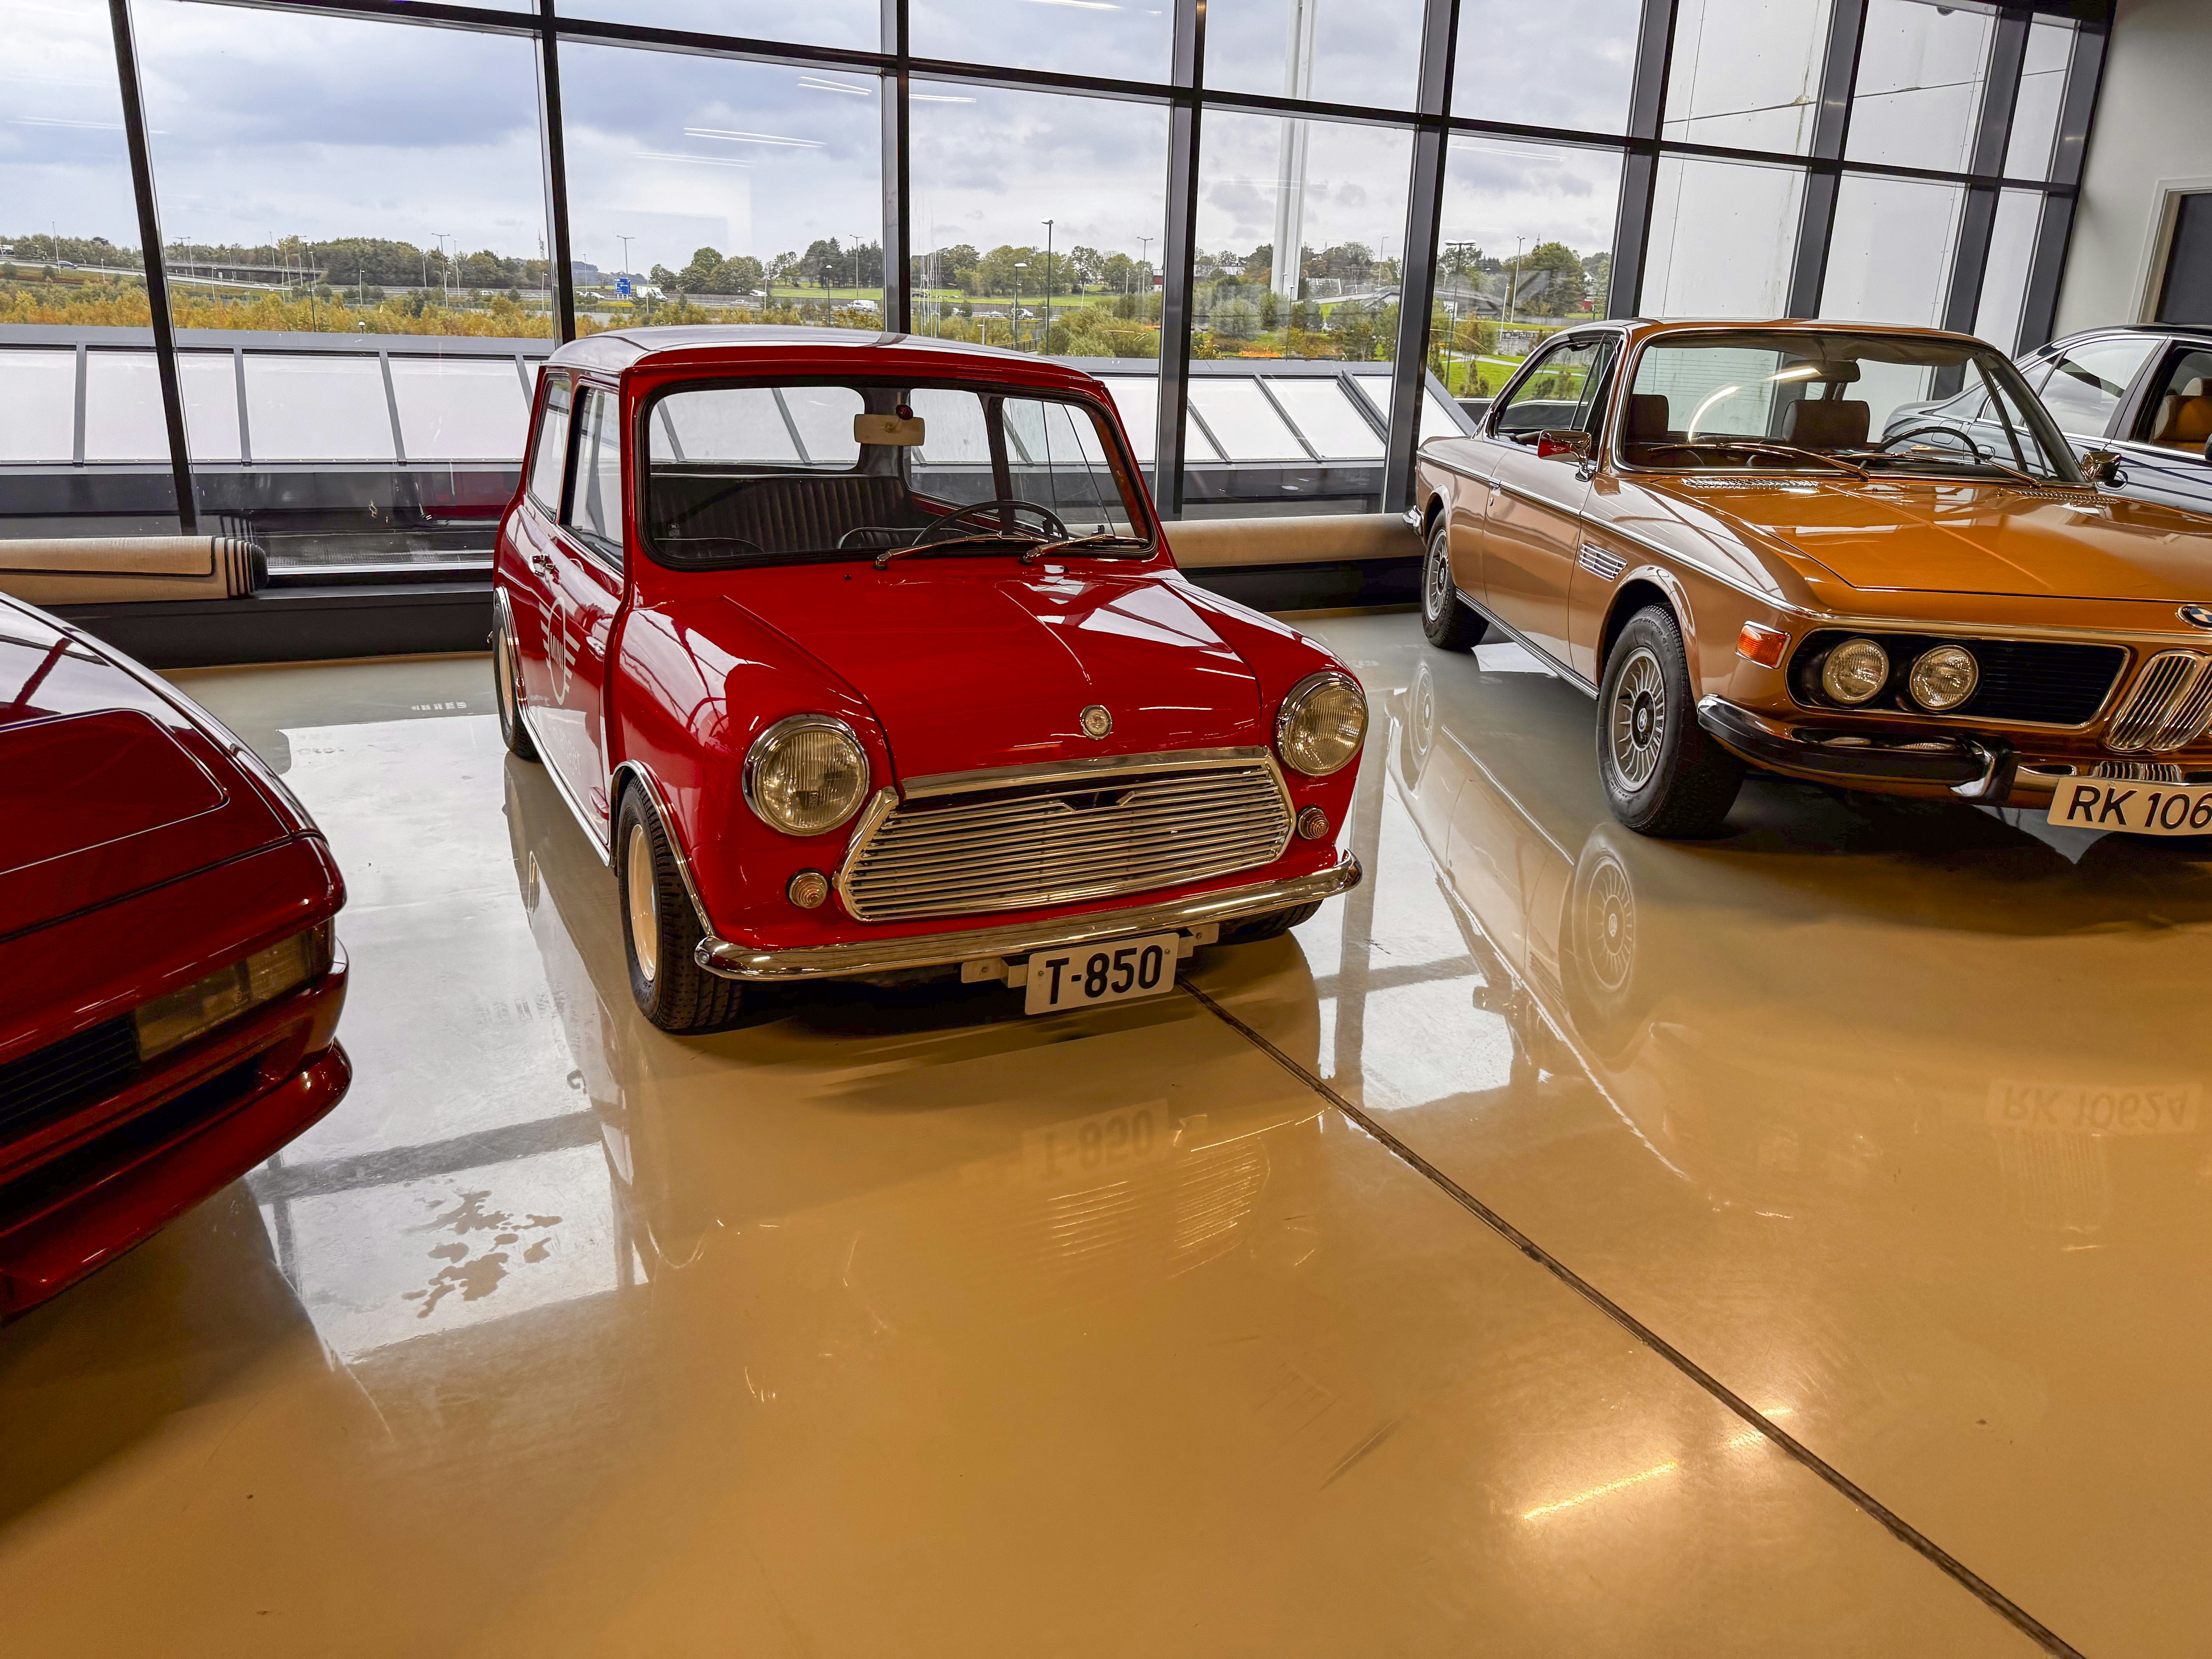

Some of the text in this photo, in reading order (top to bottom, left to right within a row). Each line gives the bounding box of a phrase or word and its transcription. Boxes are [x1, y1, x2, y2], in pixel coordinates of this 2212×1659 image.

[2066, 785, 2212, 830] RK 106
[1046, 945, 1163, 1005] T-850
